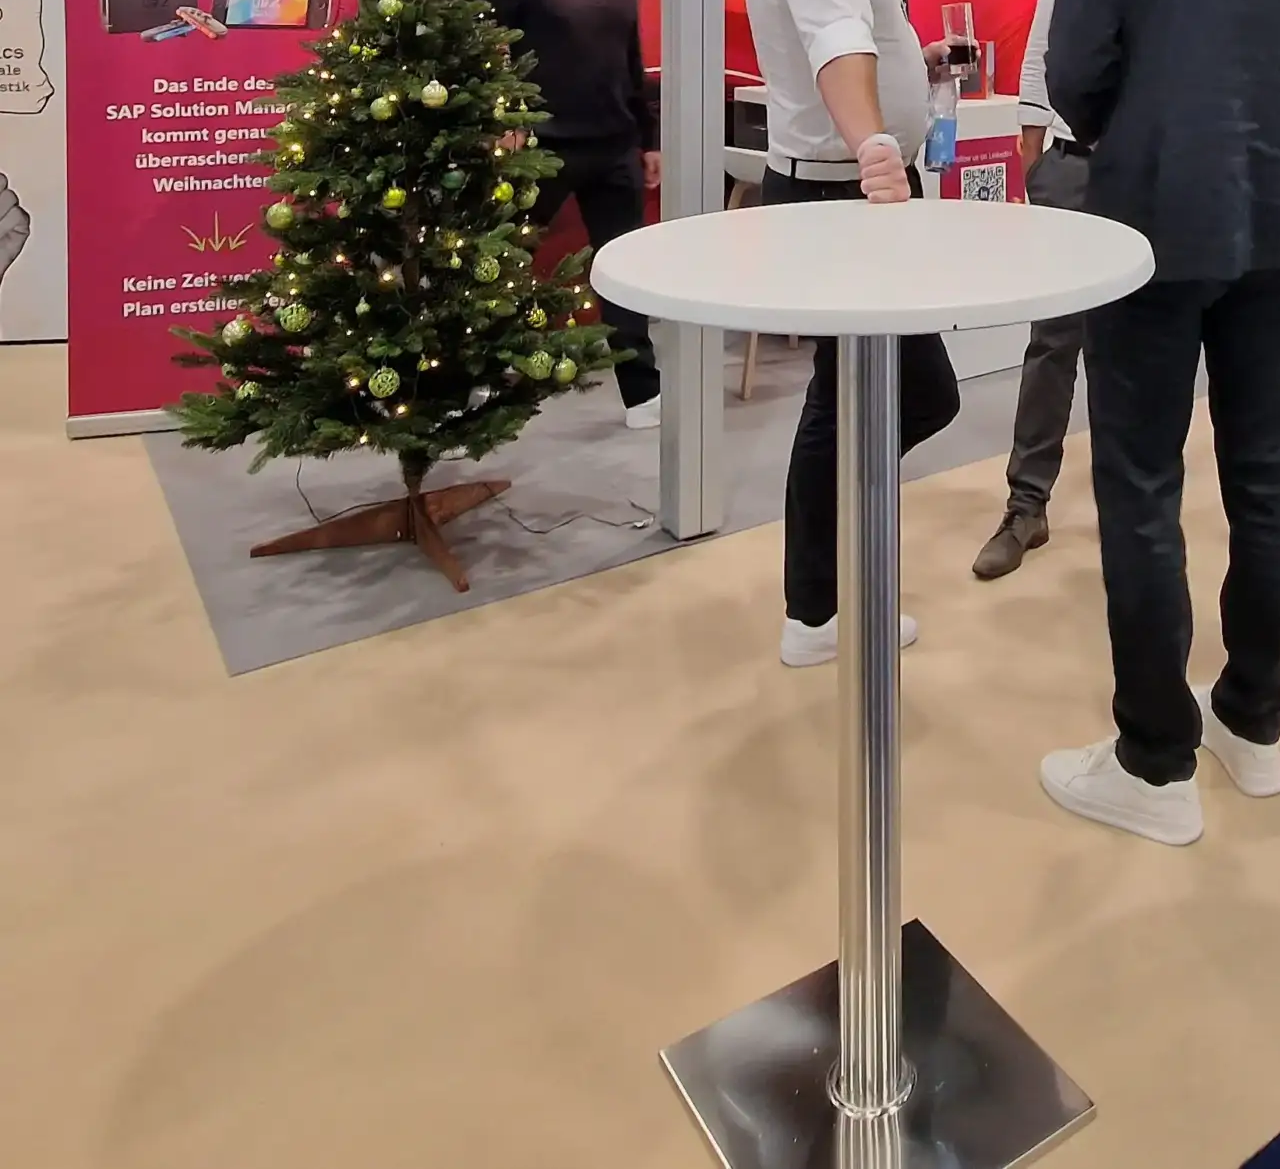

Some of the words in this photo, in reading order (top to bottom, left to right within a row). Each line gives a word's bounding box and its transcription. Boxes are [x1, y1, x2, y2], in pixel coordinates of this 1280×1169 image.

[153, 79, 188, 94] Das
[193, 77, 238, 93] Ende
[243, 76, 274, 91] des
[106, 104, 145, 120] SAP
[150, 102, 228, 118] Solution
[142, 128, 209, 144] kommt
[123, 276, 176, 292] Keine
[182, 272, 217, 288] Zeit
[123, 301, 164, 317] Plan
